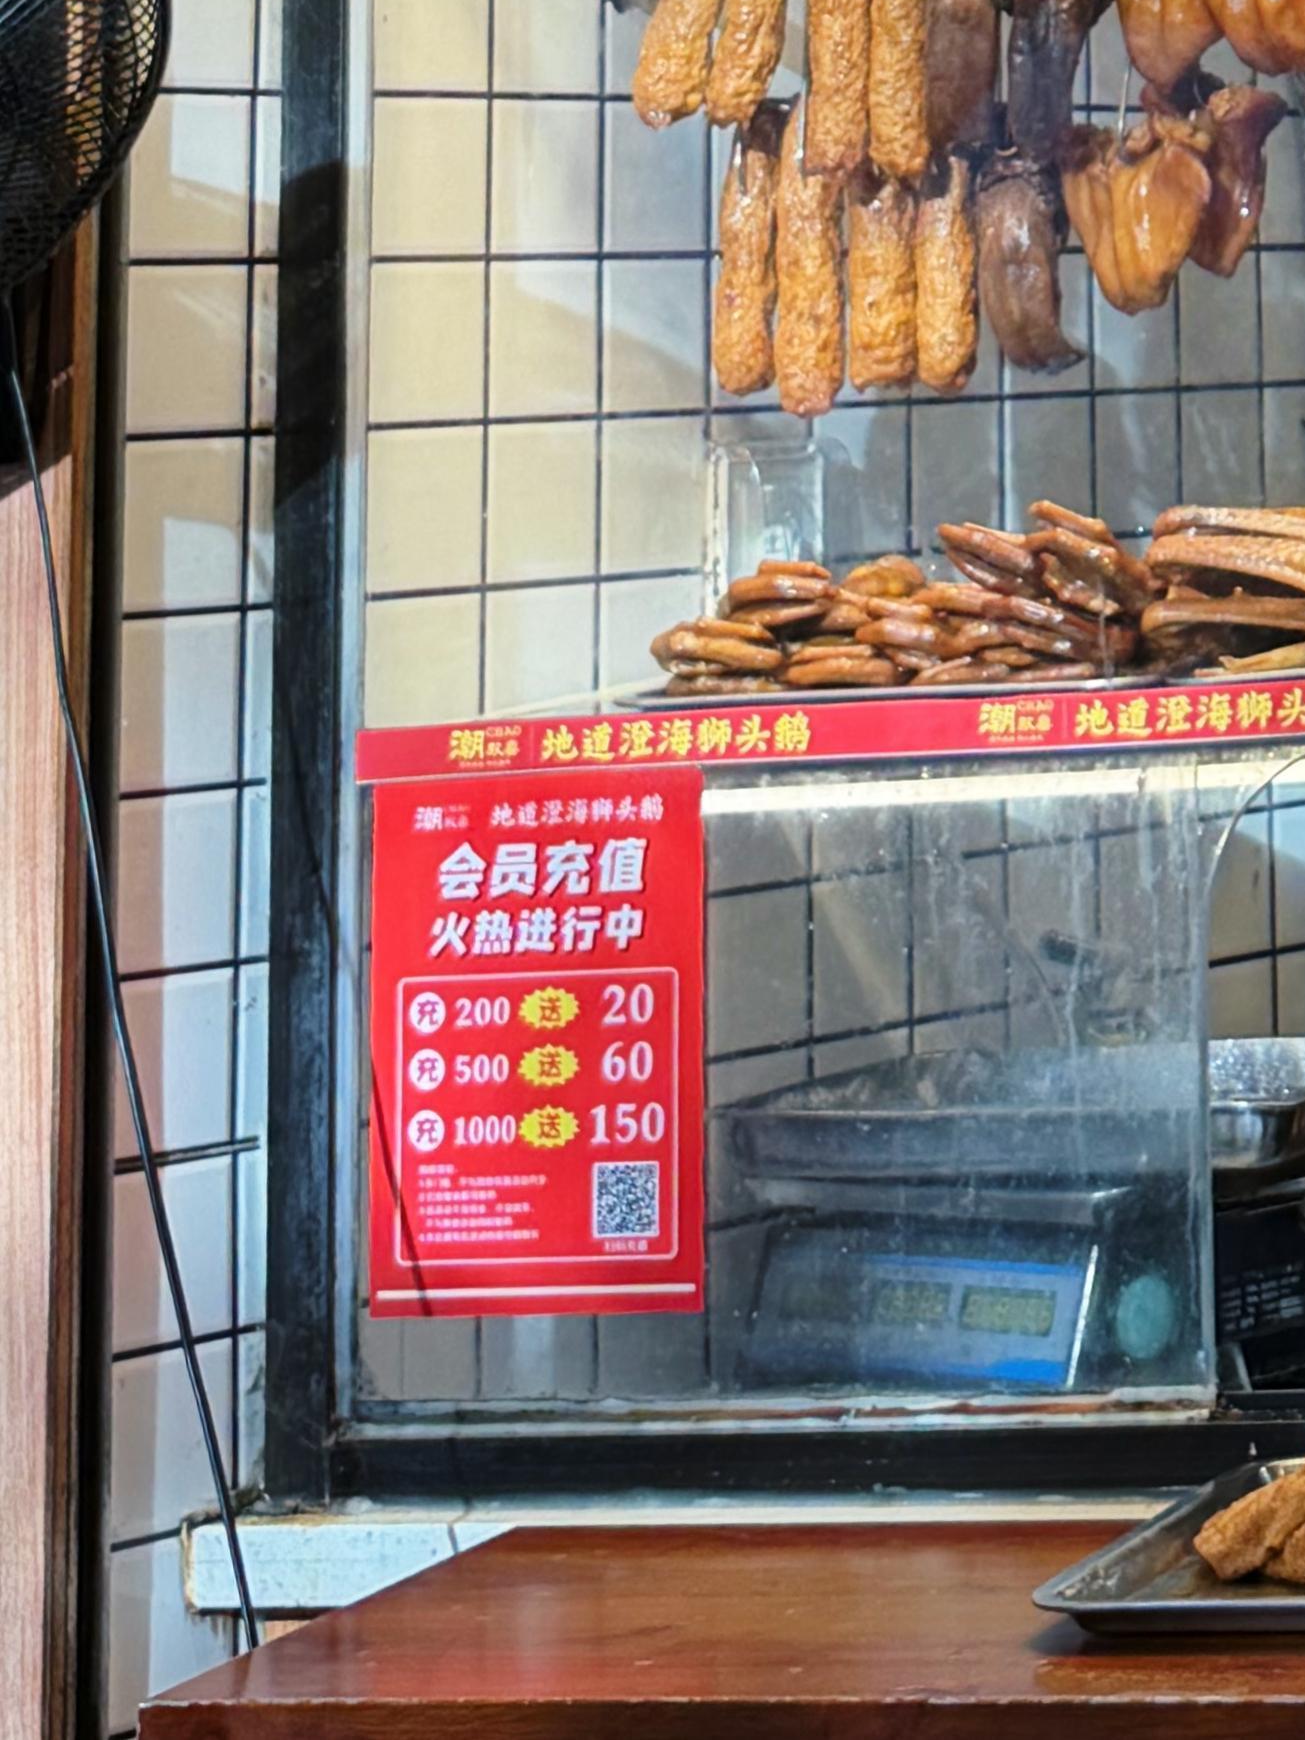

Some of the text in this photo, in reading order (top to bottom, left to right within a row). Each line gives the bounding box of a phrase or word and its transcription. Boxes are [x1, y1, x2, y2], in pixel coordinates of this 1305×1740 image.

[541, 710, 811, 762] 地道澄海狮头鹅
[439, 837, 647, 900] 会员充值
[429, 904, 644, 958] 火热进行中
[416, 983, 654, 1027] 充 200 送 20
[416, 1041, 653, 1083] 充 500 送 60
[416, 1102, 665, 1146] 充 1000 送 150
